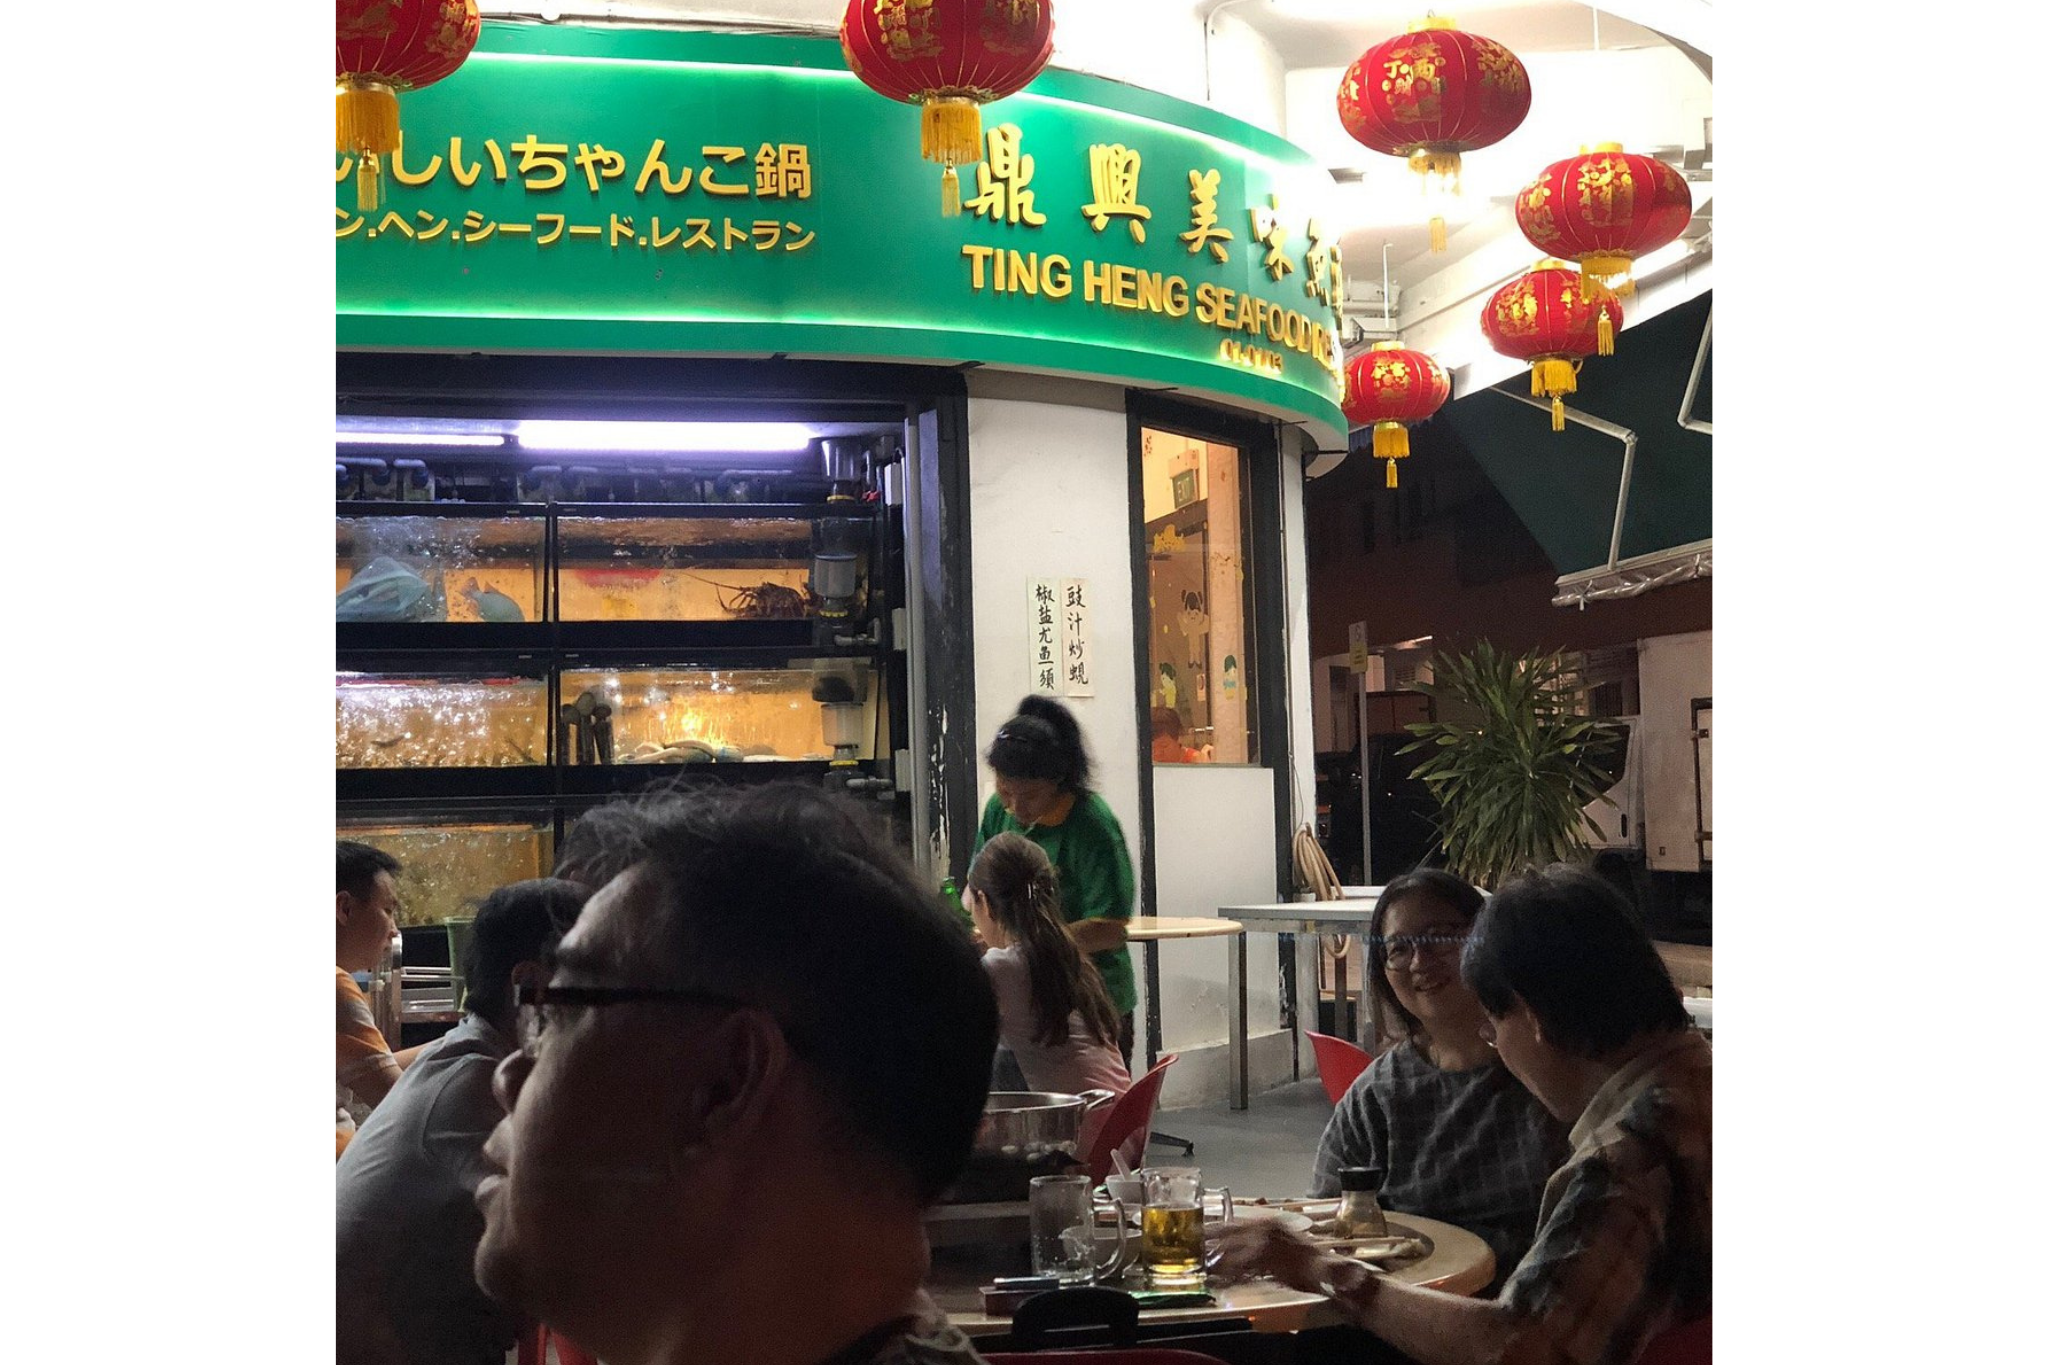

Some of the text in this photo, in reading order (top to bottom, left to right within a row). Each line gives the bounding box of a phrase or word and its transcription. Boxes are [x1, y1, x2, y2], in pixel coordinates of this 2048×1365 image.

[961, 244, 1072, 298] TING
[1083, 259, 1188, 317] HENG
[1195, 281, 1311, 352] SEAFOOD
